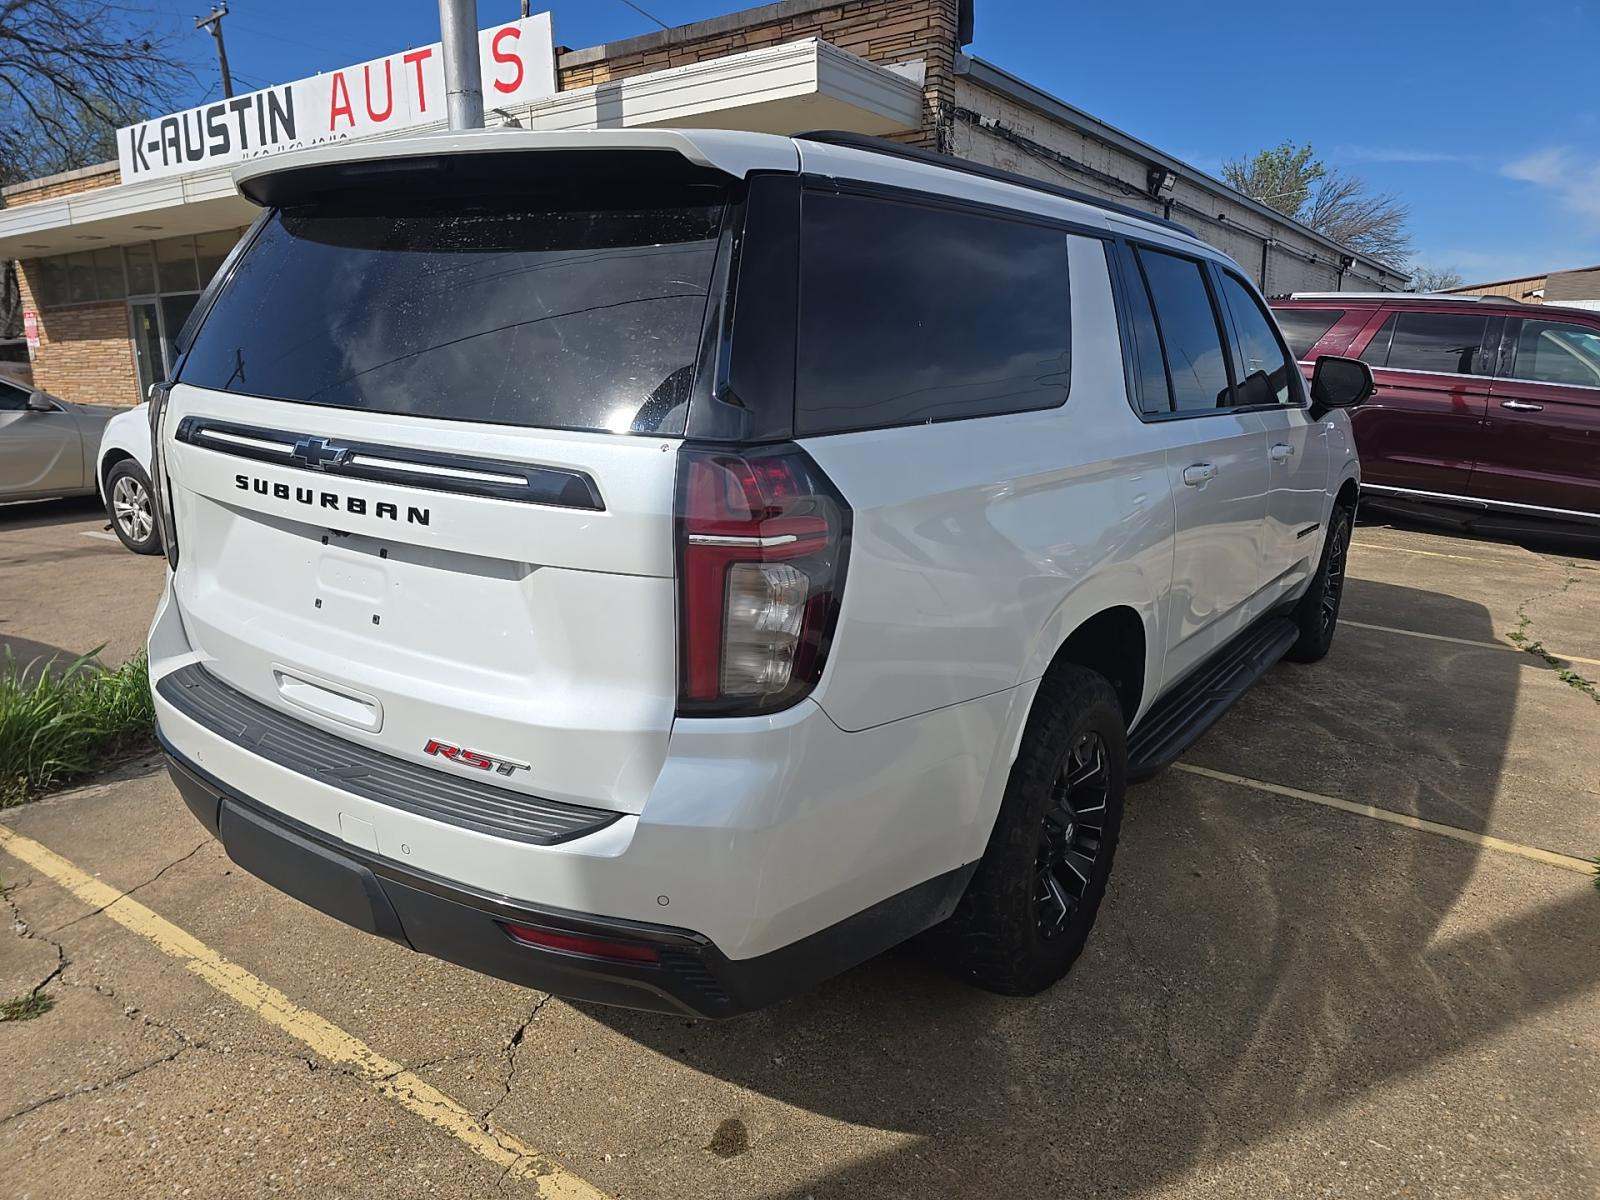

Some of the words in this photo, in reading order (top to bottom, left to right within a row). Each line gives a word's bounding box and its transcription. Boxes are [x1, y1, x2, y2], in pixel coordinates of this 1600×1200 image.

[131, 86, 297, 173] K-AUSTIN
[329, 27, 524, 131] AUTS
[235, 474, 430, 526] SUBURBAN
[424, 739, 531, 777] RST
